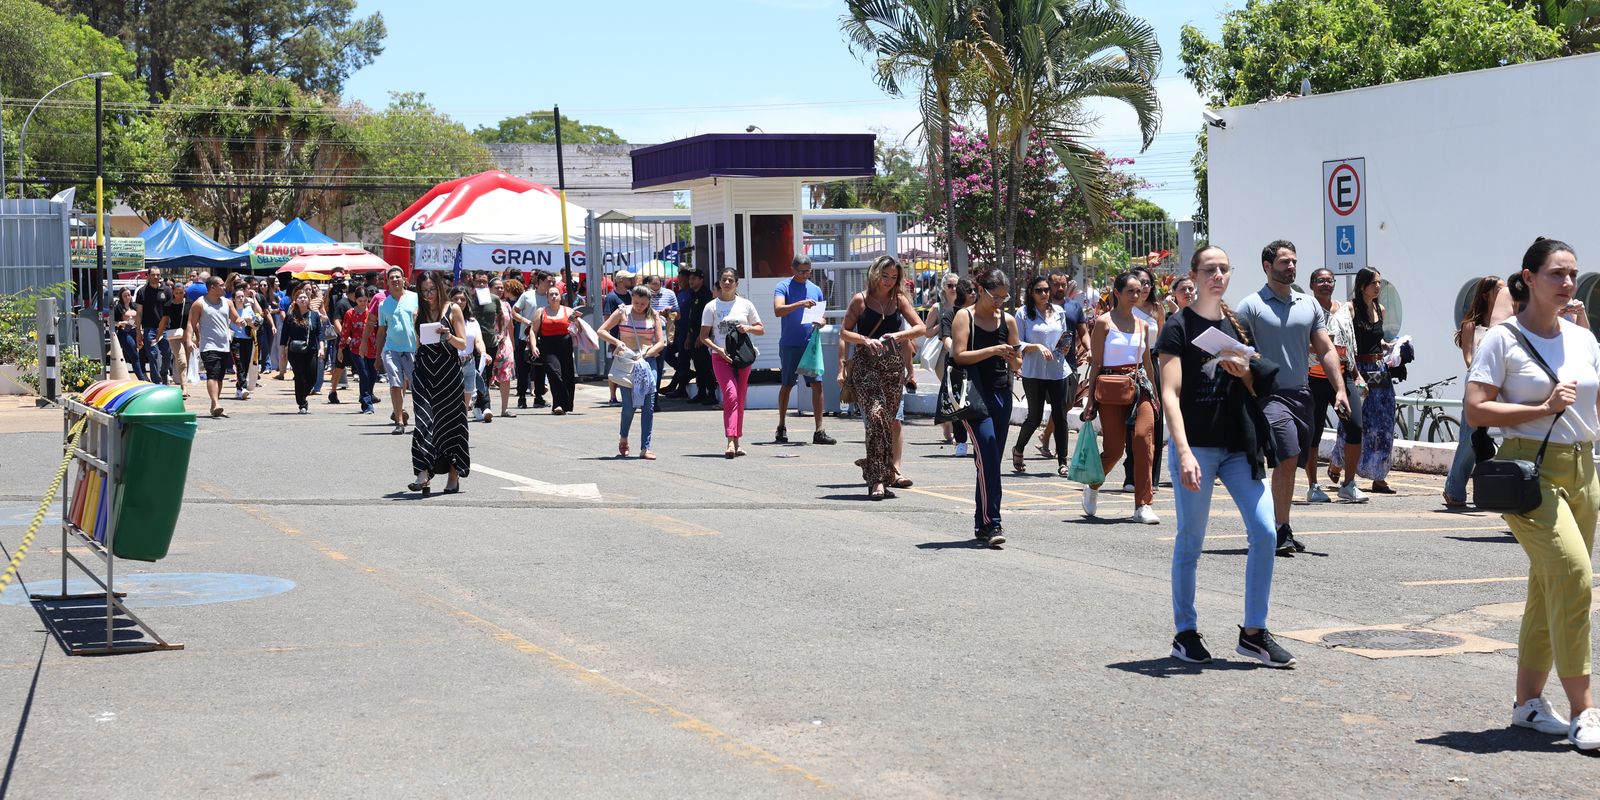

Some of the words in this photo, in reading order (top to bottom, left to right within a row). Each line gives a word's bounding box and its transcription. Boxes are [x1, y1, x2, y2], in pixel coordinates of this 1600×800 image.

[1337, 175, 1352, 207] E
[491, 248, 551, 265] GRAN
[571, 250, 631, 267] GAN
